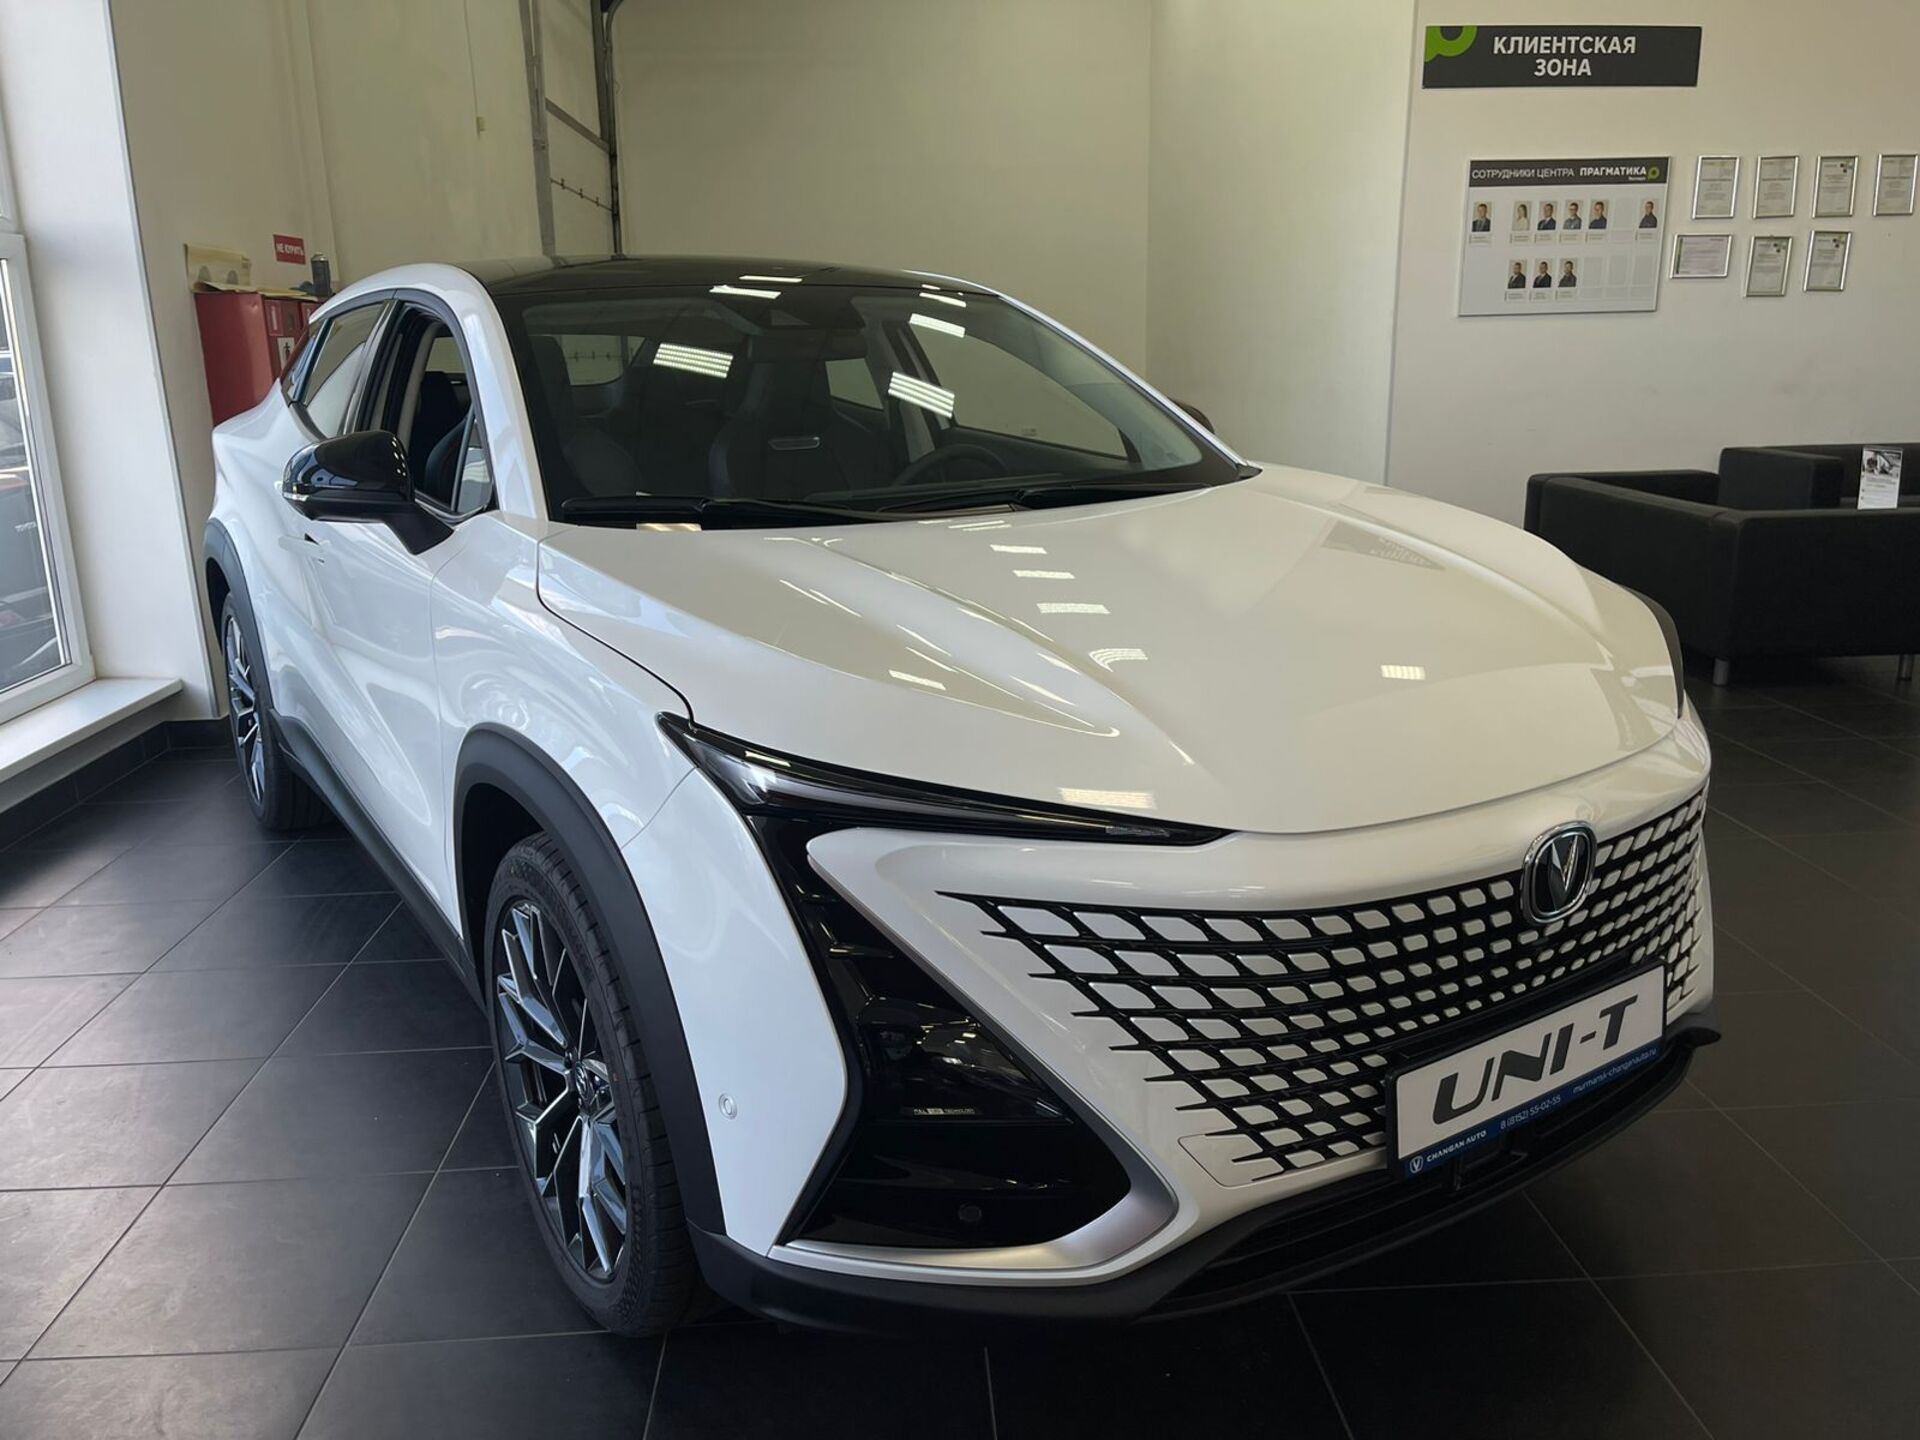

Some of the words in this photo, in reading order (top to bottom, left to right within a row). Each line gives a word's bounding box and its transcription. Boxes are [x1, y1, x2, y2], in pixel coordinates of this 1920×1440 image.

[1493, 36, 1636, 55] КЛИЕНТСКАЯ
[1534, 58, 1592, 76] ЗОНА
[1472, 168, 1535, 179] СОТРУДНИКИ
[1537, 167, 1575, 178] ЦЕНТРА
[1580, 166, 1647, 177] ПРАГМАТИКА
[276, 243, 285, 253] НЕ
[1432, 994, 1638, 1125] UNI-T
[1426, 1140, 1465, 1162] CHANGAN
[1466, 1130, 1487, 1145] AUTO
